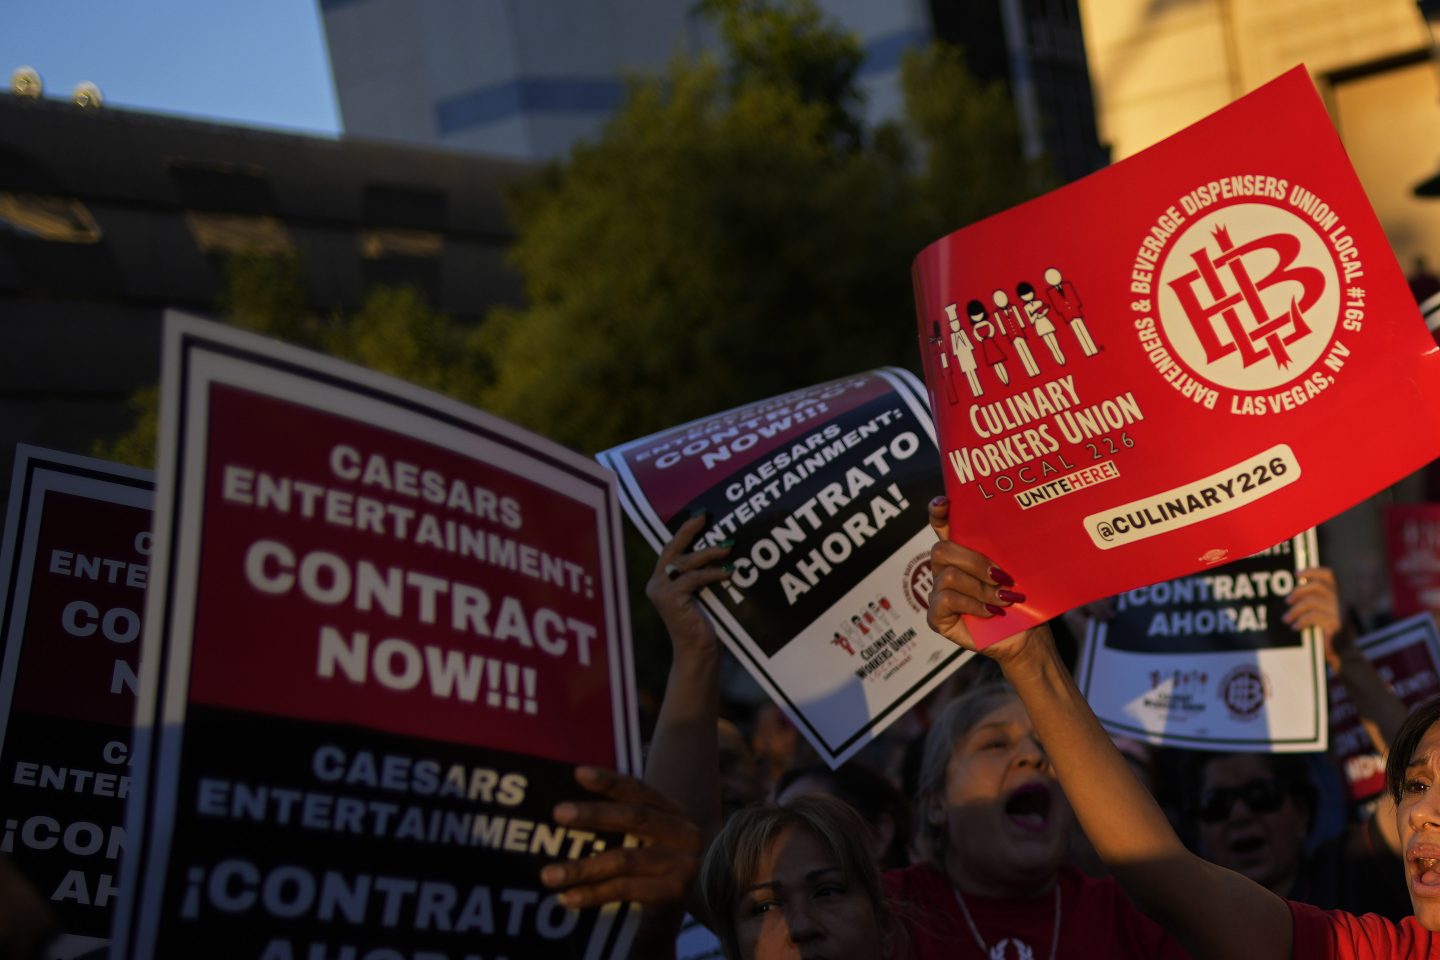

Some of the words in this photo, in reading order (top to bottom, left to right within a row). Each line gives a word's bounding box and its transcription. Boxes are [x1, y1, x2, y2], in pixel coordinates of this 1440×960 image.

[1179, 174, 1289, 217] DISPENSERS
[1289, 184, 1340, 233] UNION
[1130, 206, 1187, 295] BEVERAGE
[1328, 225, 1364, 284] LOCAL
[1130, 298, 1152, 314] &
[1342, 286, 1366, 333] #165
[1134, 317, 1220, 411] BARTENDERS
[1230, 394, 1267, 416] LAS
[1266, 371, 1336, 415] VEGAS,
[1324, 340, 1352, 374] NV
[701, 402, 829, 471] NOW!!!
[948, 423, 1060, 485] WORKERS
[1054, 391, 1144, 445] UNION
[968, 374, 1081, 439] CULINARY
[328, 443, 524, 530] CAESARS
[692, 408, 904, 552] ENTERTAINMENT:
[725, 424, 842, 502] CAESARS
[978, 455, 1075, 500] LOCAL
[1086, 432, 1135, 460] 226
[1016, 461, 1118, 508] UNITEHERE!
[1096, 456, 1288, 542] @CULINARY226
[221, 463, 595, 599] ENTERTAINMENT:
[720, 430, 920, 606] ¡CONTRATO
[779, 482, 911, 607] AHORA!
[243, 538, 598, 667] CONTRACT
[1148, 604, 1269, 638] AHORA!
[315, 625, 540, 716] NOW!!!
[311, 743, 529, 808] CAESARS
[194, 776, 607, 859] ENTERTAINMENT:
[177, 856, 582, 941] ¡CONTRATO
